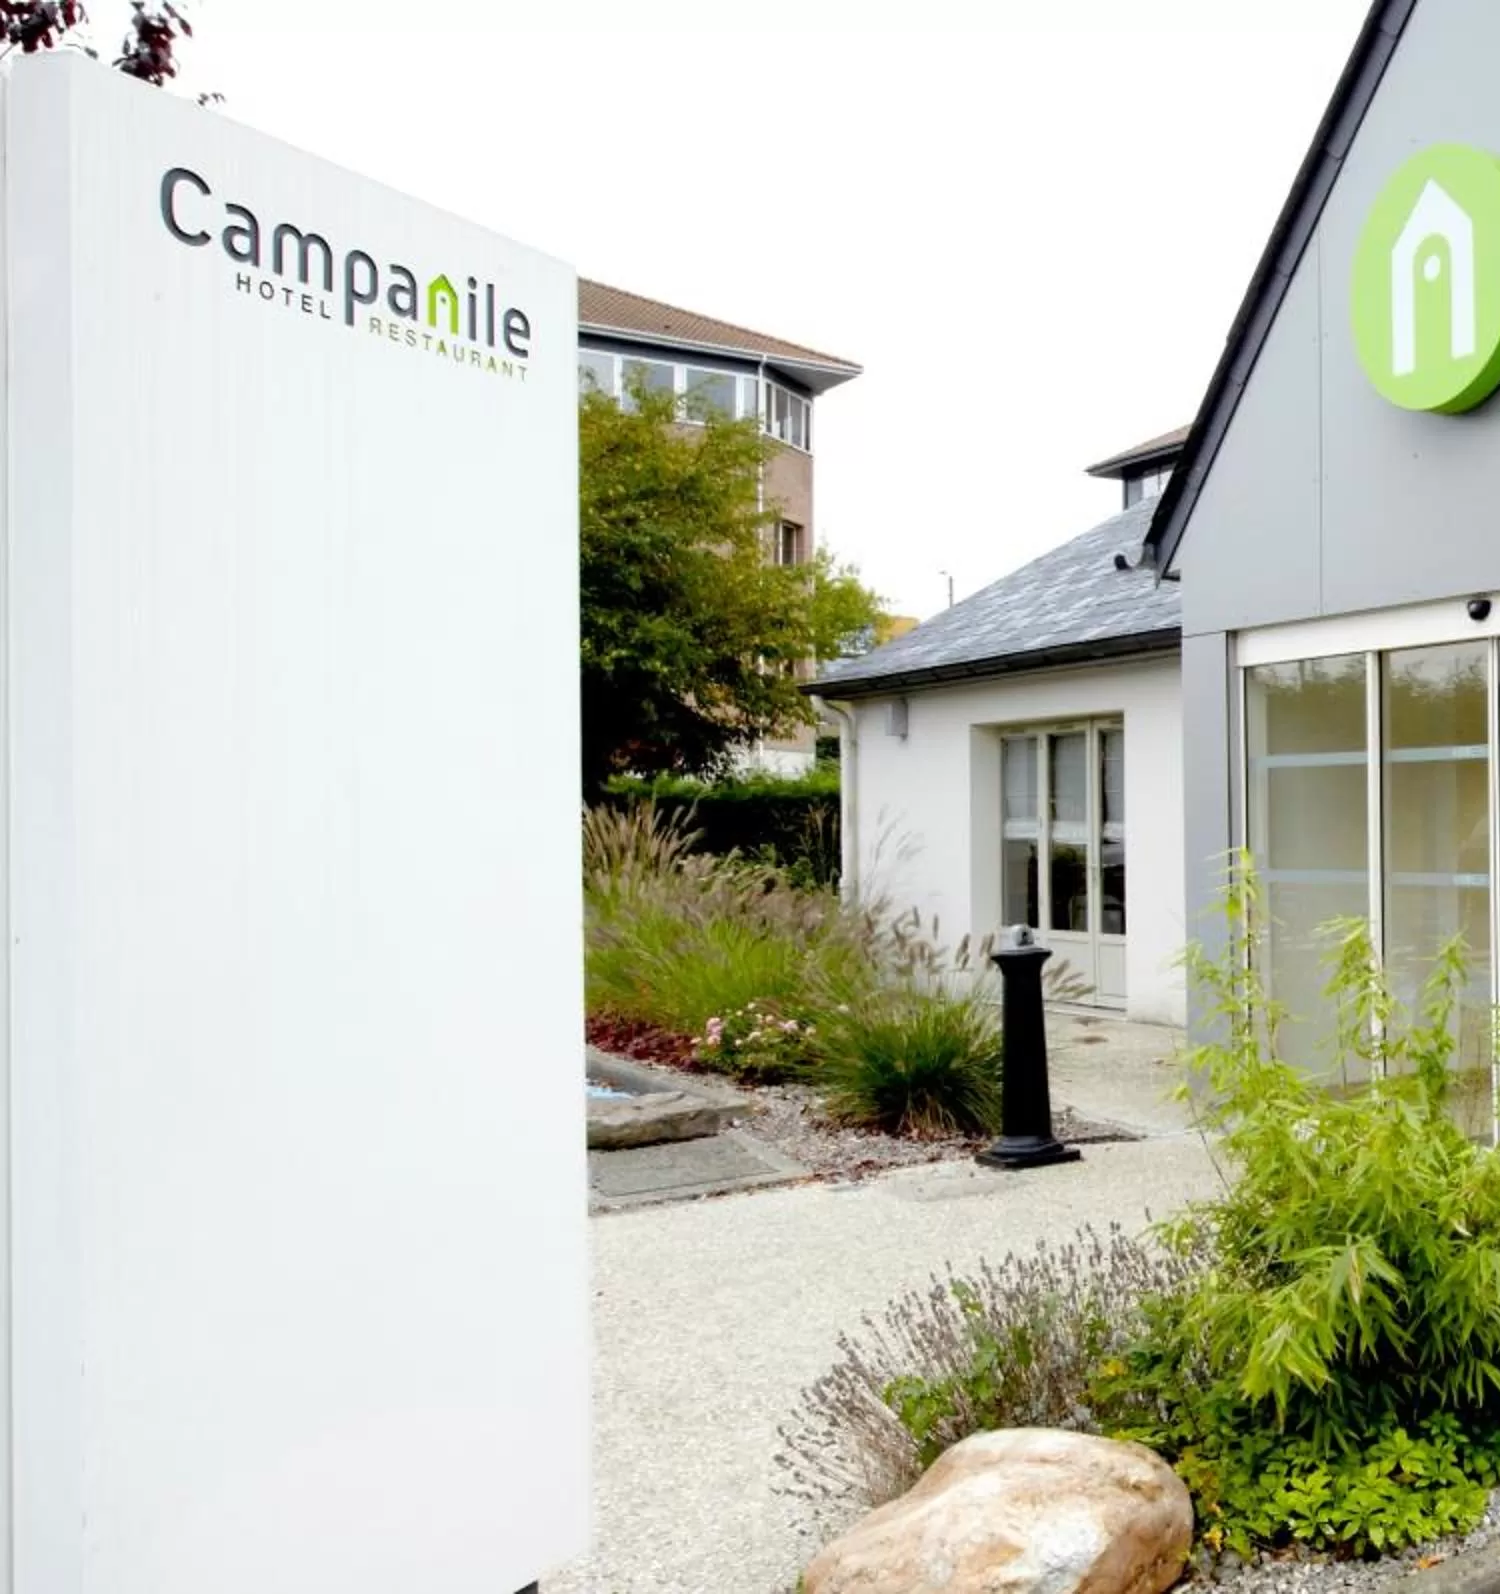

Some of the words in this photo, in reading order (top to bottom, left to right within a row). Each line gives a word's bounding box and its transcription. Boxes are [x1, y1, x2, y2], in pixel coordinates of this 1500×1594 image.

[160, 166, 531, 359] Campanile
[236, 271, 332, 320] HOTEL
[369, 317, 529, 382] RESTAURANT
